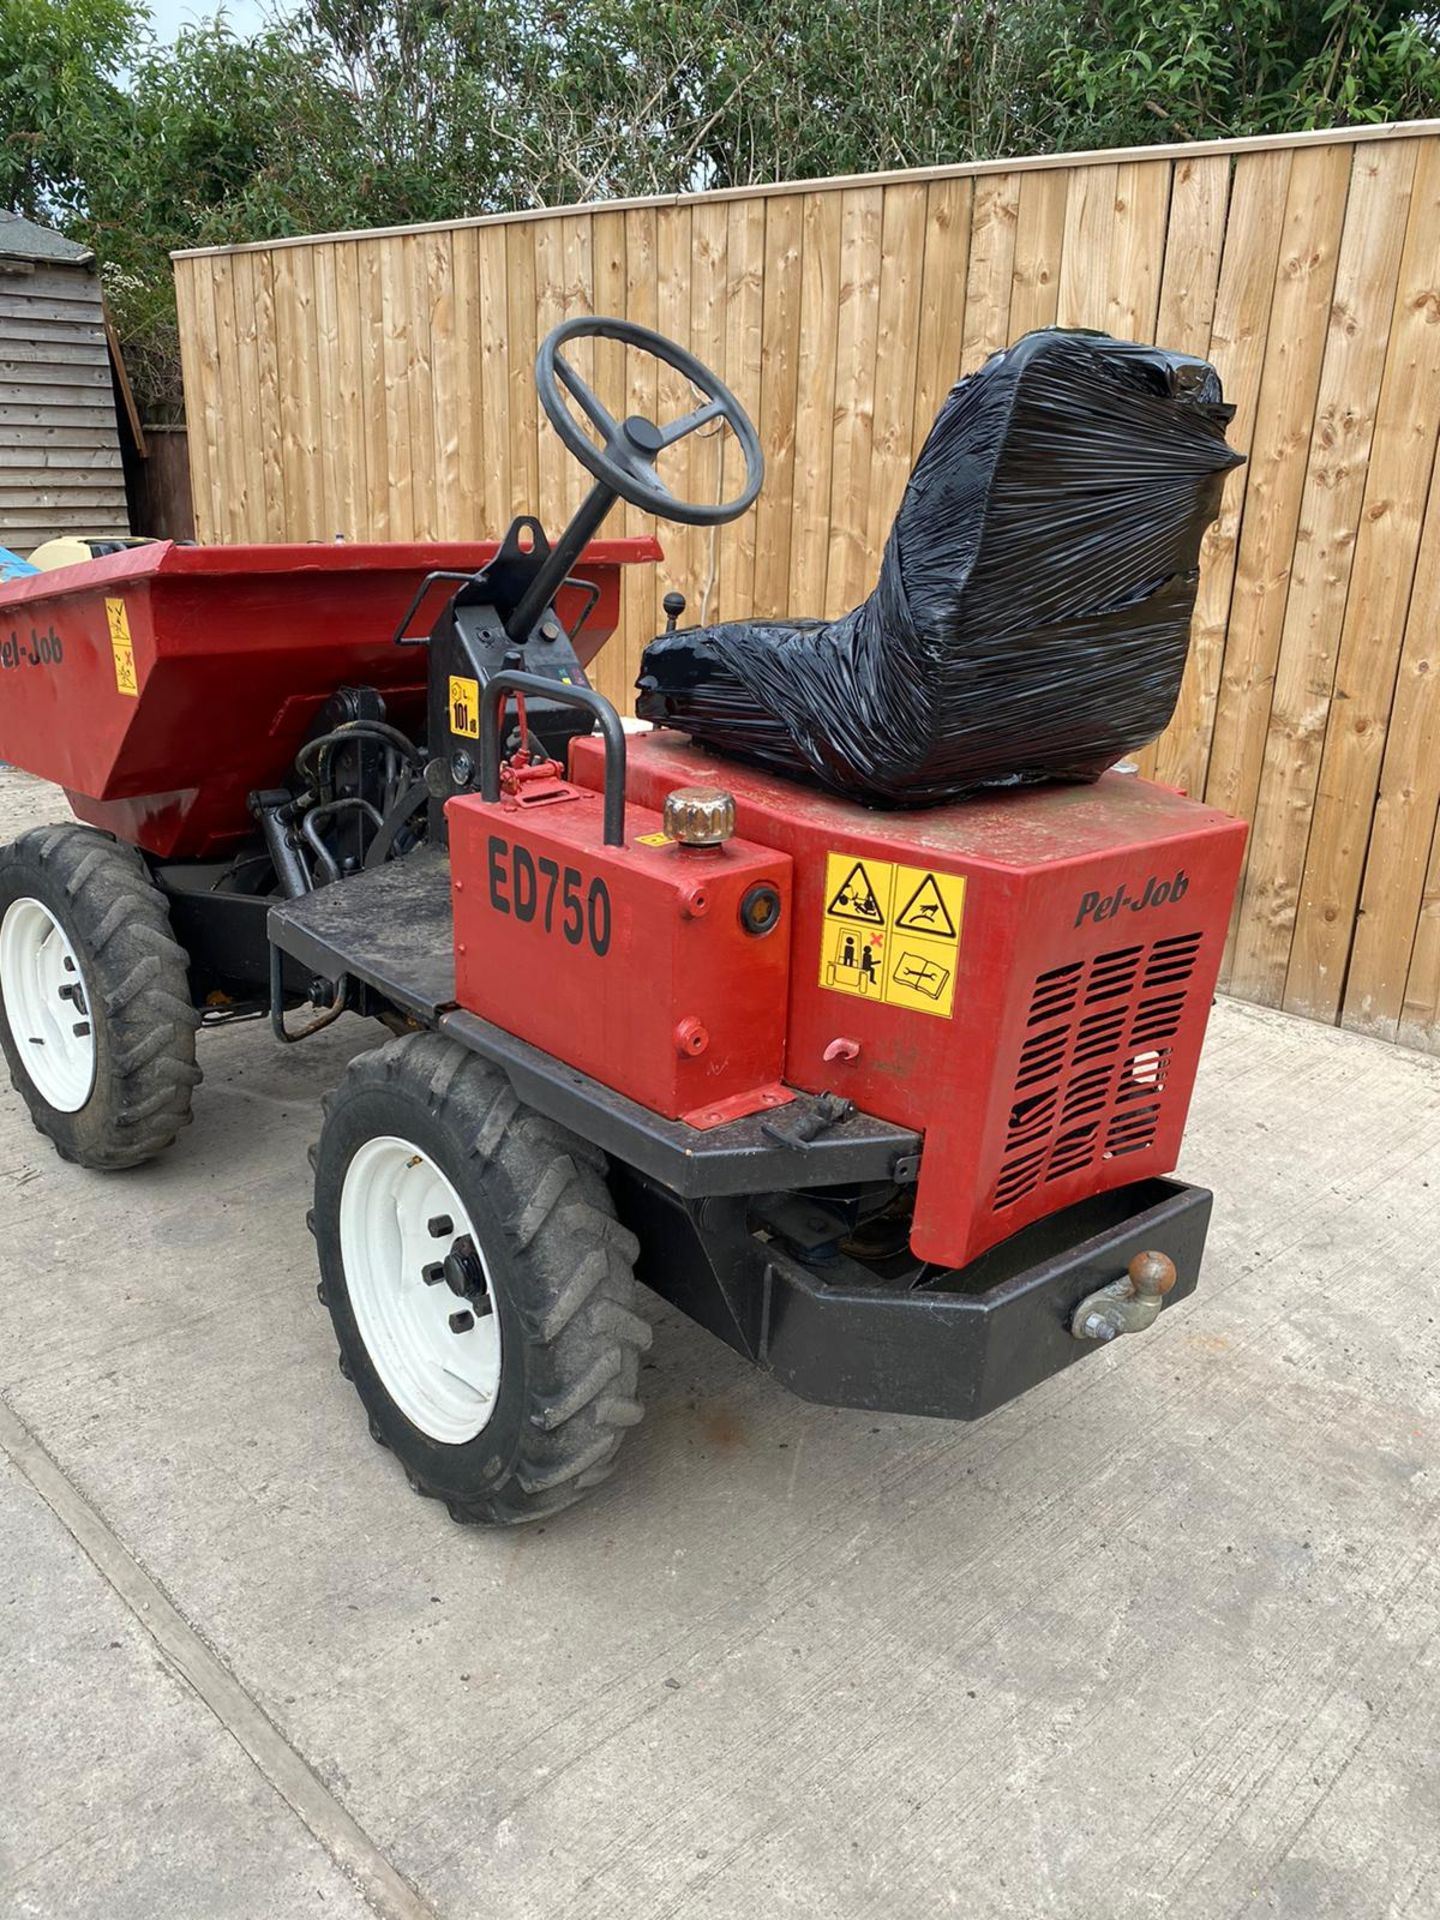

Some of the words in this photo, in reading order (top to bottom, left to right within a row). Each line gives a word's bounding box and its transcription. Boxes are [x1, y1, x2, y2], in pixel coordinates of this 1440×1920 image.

[0, 626, 63, 668] el-Job
[454, 702, 468, 731] 101
[488, 835, 611, 957] ED750
[1074, 869, 1190, 929] Pel-Job
